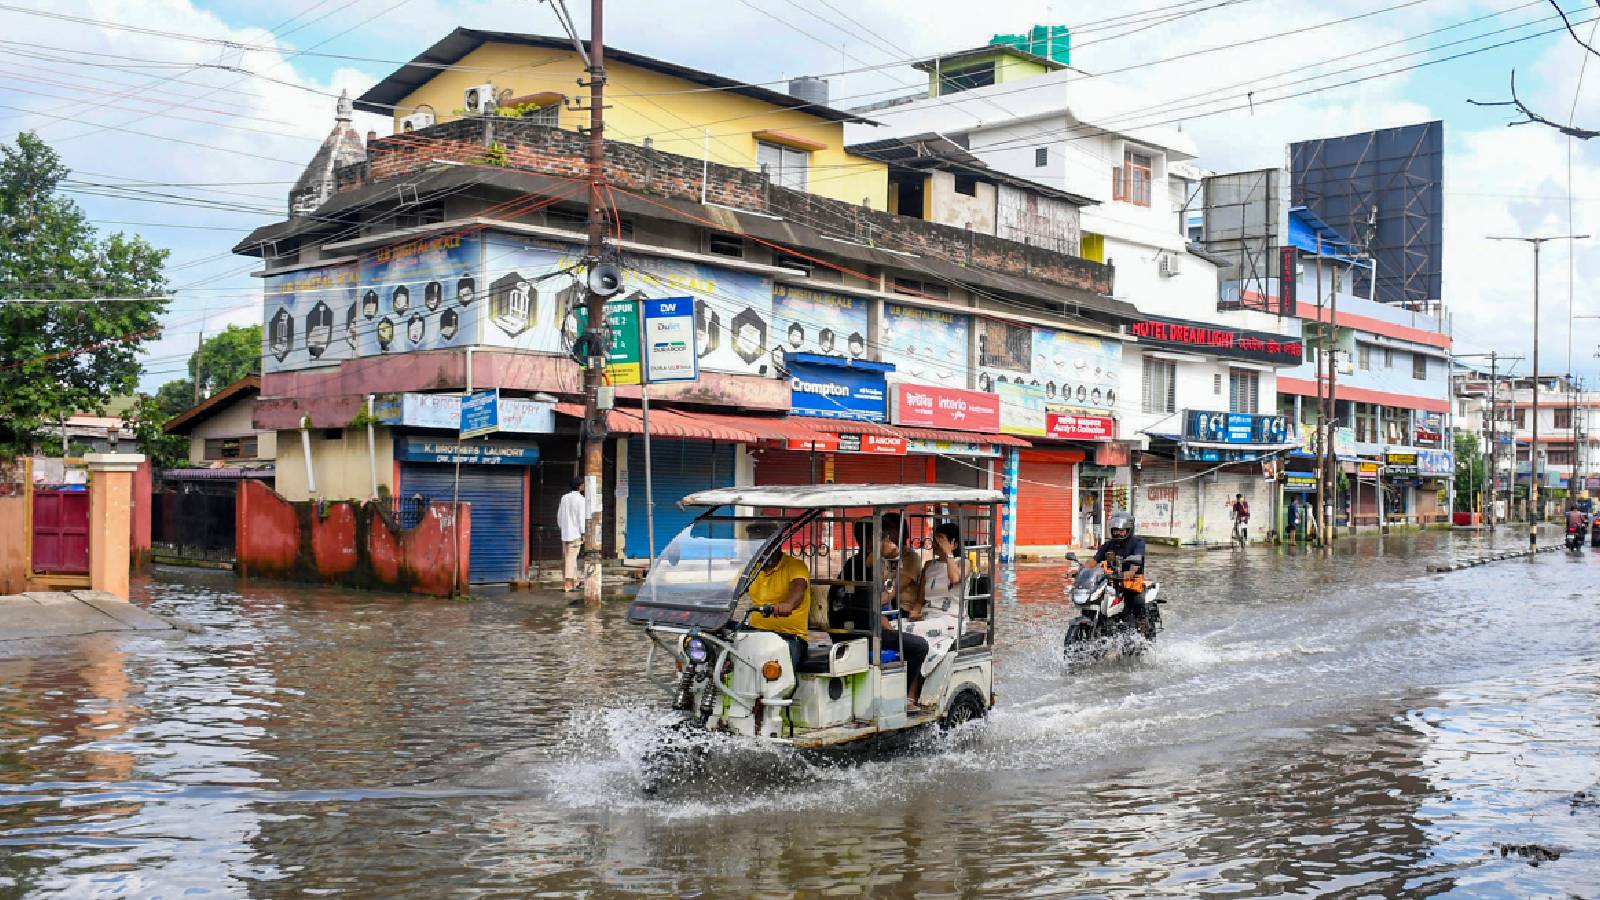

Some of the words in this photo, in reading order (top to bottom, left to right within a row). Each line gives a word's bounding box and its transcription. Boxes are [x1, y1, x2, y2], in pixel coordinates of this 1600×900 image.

[1133, 320, 1168, 340] HOTEL
[1170, 324, 1204, 344] DREAM
[1206, 328, 1233, 349] LIGHT
[792, 377, 849, 398] Crompton
[435, 445, 479, 455] BROTHERS
[484, 446, 525, 458] LAUNDRY
